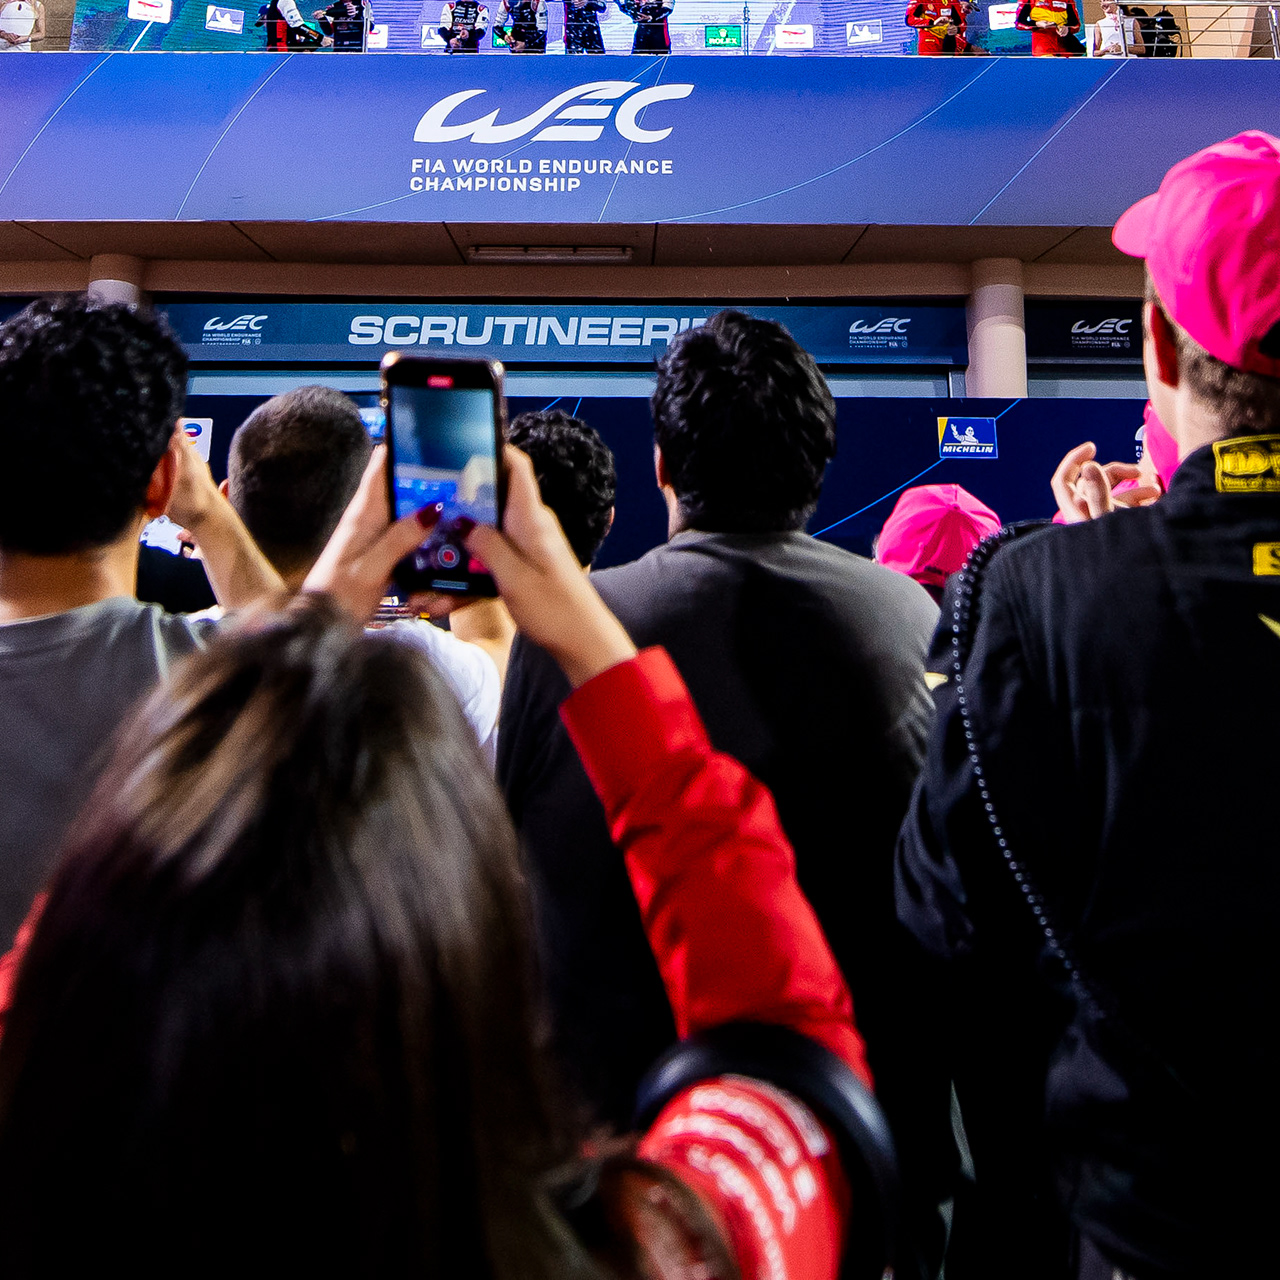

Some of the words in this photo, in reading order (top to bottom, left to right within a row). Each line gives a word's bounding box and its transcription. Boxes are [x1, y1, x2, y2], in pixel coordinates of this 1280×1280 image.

[708, 37, 737, 45] ROLEX
[412, 80, 696, 145] WEC
[411, 159, 447, 174] FIA
[452, 159, 533, 174] WORLD
[538, 159, 674, 175] ENDURANCE
[409, 176, 582, 192] CHAMPIONSHIP
[203, 314, 269, 331] WEC
[849, 317, 912, 333] WEC
[1071, 318, 1133, 333] WEC
[348, 316, 709, 346] SCRUTINEERI
